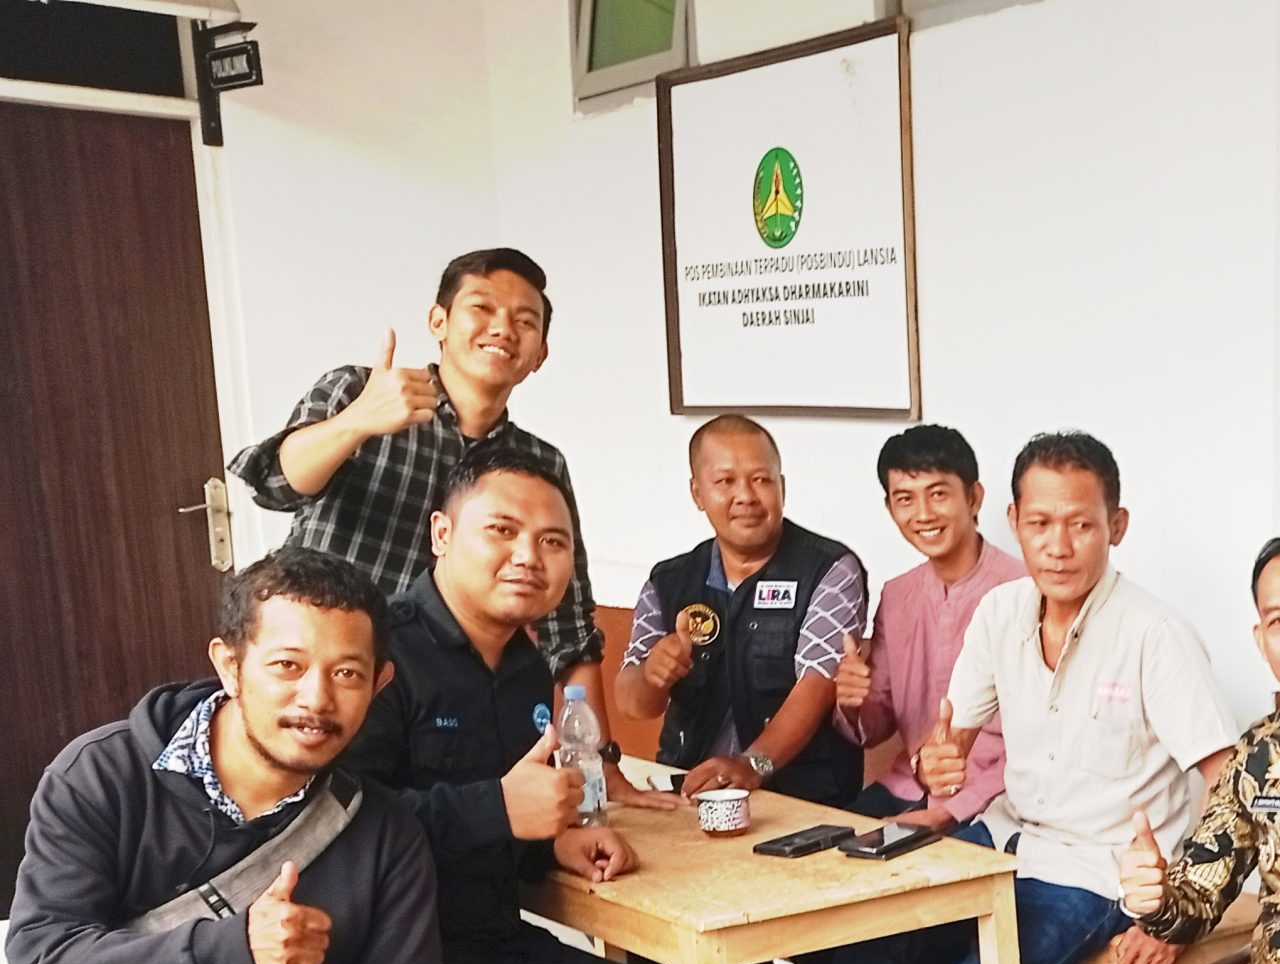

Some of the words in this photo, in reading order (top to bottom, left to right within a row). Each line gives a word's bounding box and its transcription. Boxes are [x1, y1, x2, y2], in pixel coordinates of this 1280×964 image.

[684, 265, 700, 281] POS
[702, 260, 752, 280] PEMBINAAN
[754, 255, 795, 275] TERPADU
[797, 249, 855, 275] (POSBINDU)
[857, 246, 897, 267] LANSIA
[698, 290, 729, 307] IKATAN
[731, 285, 781, 305] ADHYAKSA
[783, 279, 869, 301] DHARMAKARINI
[742, 310, 781, 328] DAERAH
[783, 308, 815, 326] SINJAI
[758, 589, 792, 601] LIRA
